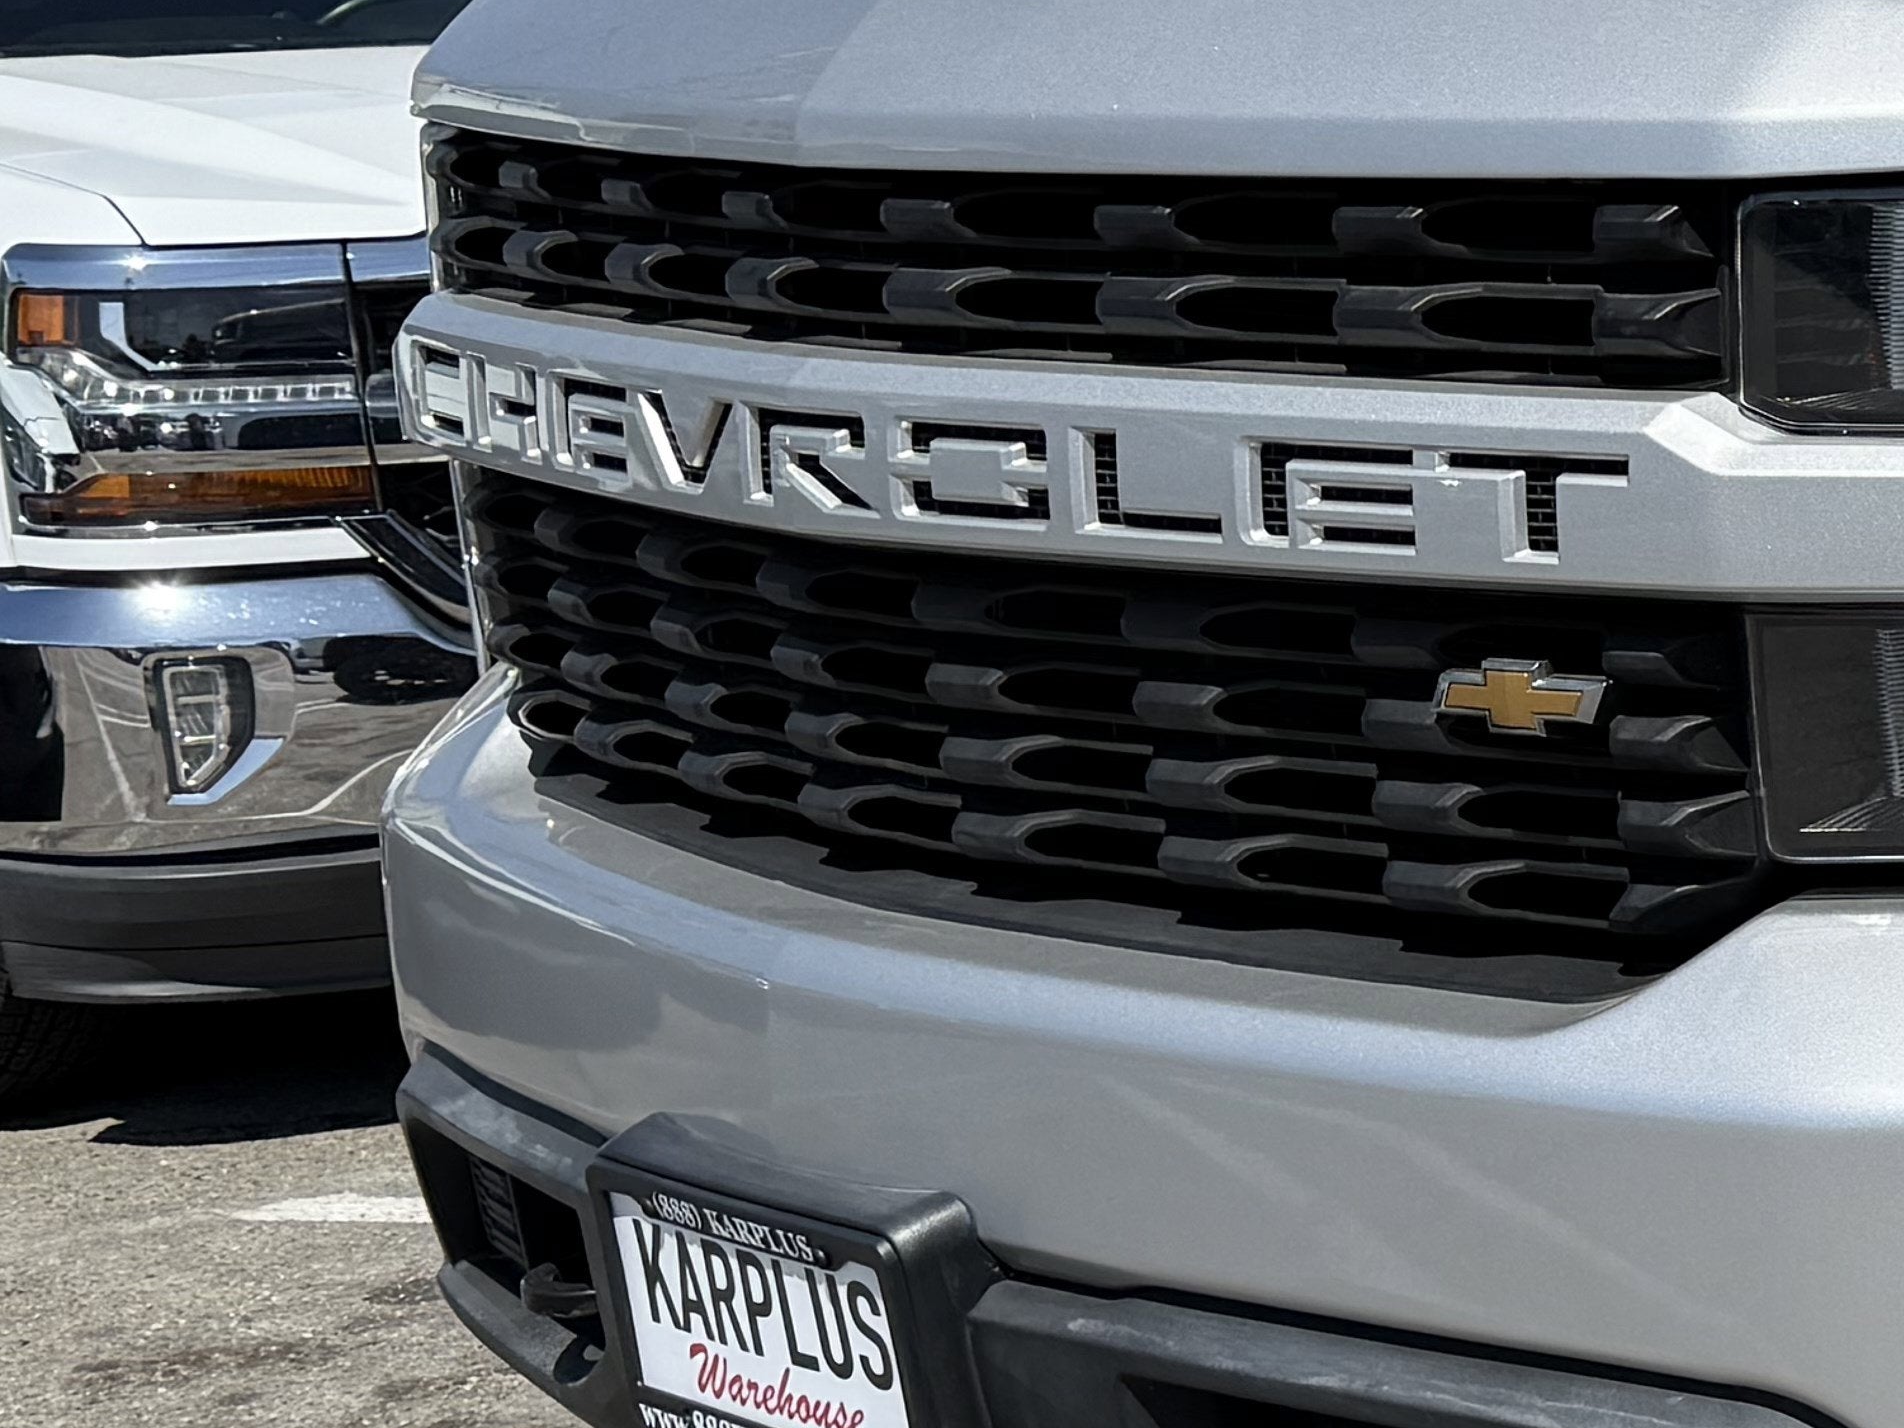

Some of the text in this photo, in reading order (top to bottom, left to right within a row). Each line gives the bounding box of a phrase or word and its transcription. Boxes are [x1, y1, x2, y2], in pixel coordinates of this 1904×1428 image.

[408, 337, 1632, 566] CHEVROLET
[632, 1218, 895, 1392] KARPLUS
[650, 1190, 814, 1262] (888) KARPLUS
